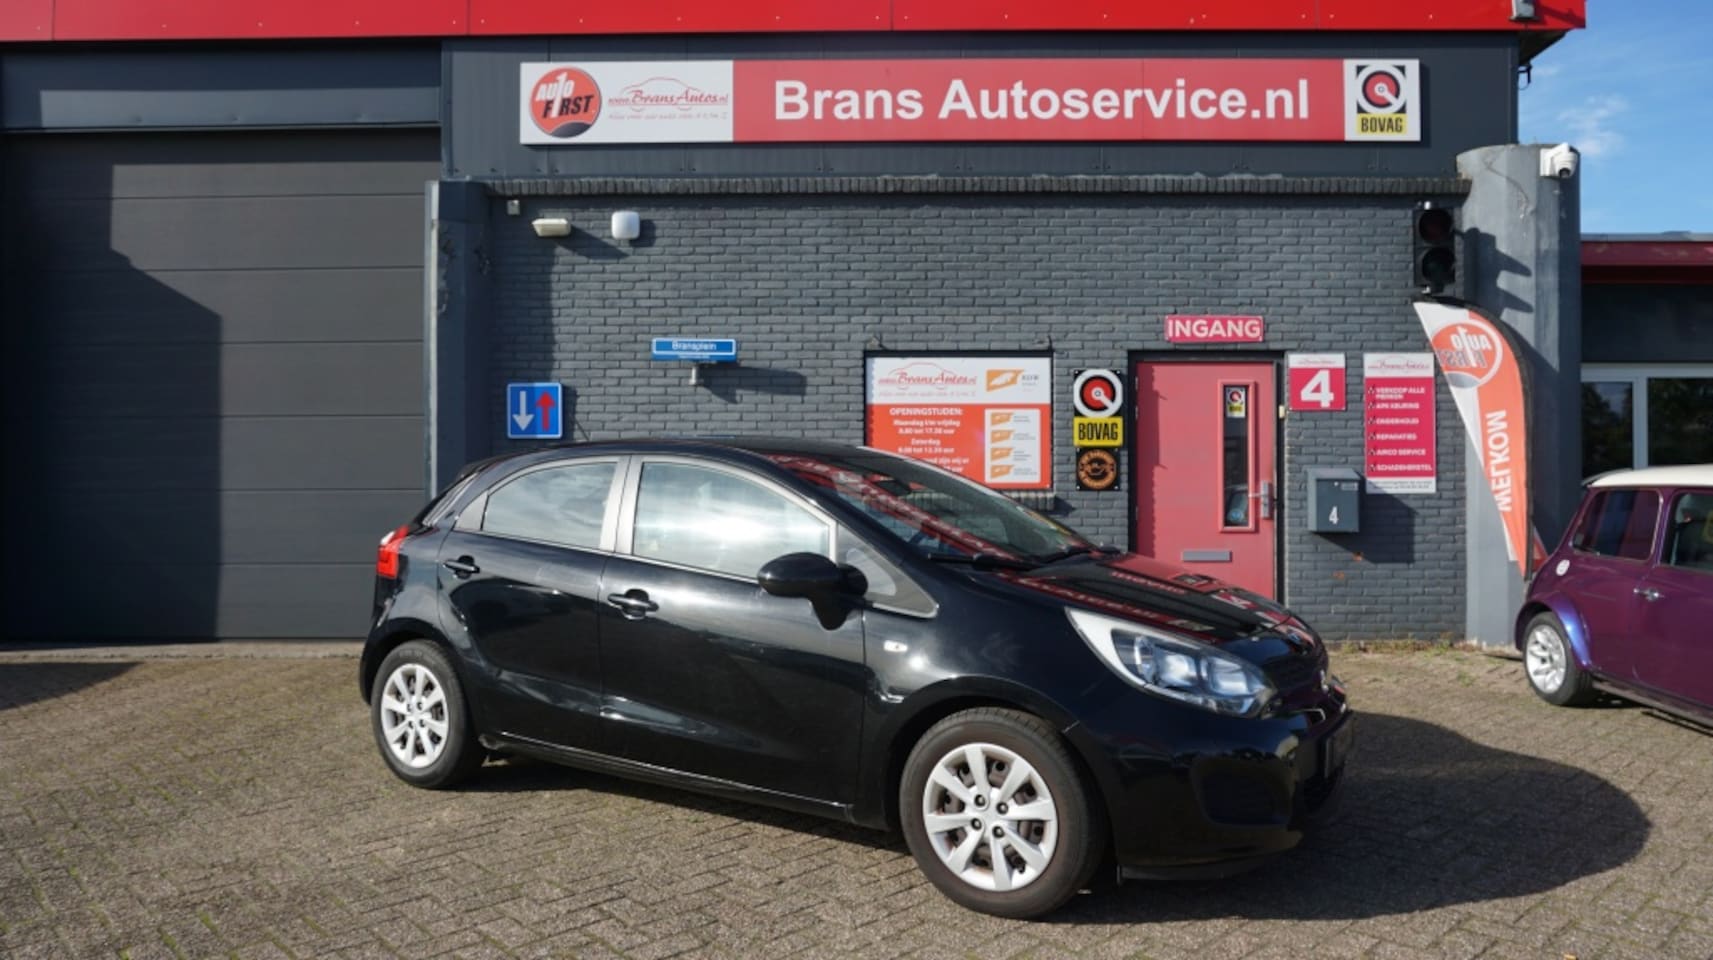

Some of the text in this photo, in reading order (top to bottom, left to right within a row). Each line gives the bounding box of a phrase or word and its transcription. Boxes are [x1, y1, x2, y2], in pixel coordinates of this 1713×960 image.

[542, 94, 594, 119] FIRST
[774, 78, 1309, 122] Brans Autoservice.nl
[1360, 117, 1403, 134] BOVAG
[1167, 319, 1261, 338] INGANG
[1300, 369, 1335, 408] 4
[1078, 422, 1118, 441] BOVAG
[1398, 448, 1426, 456] SERVICE
[1329, 506, 1339, 525] 4
